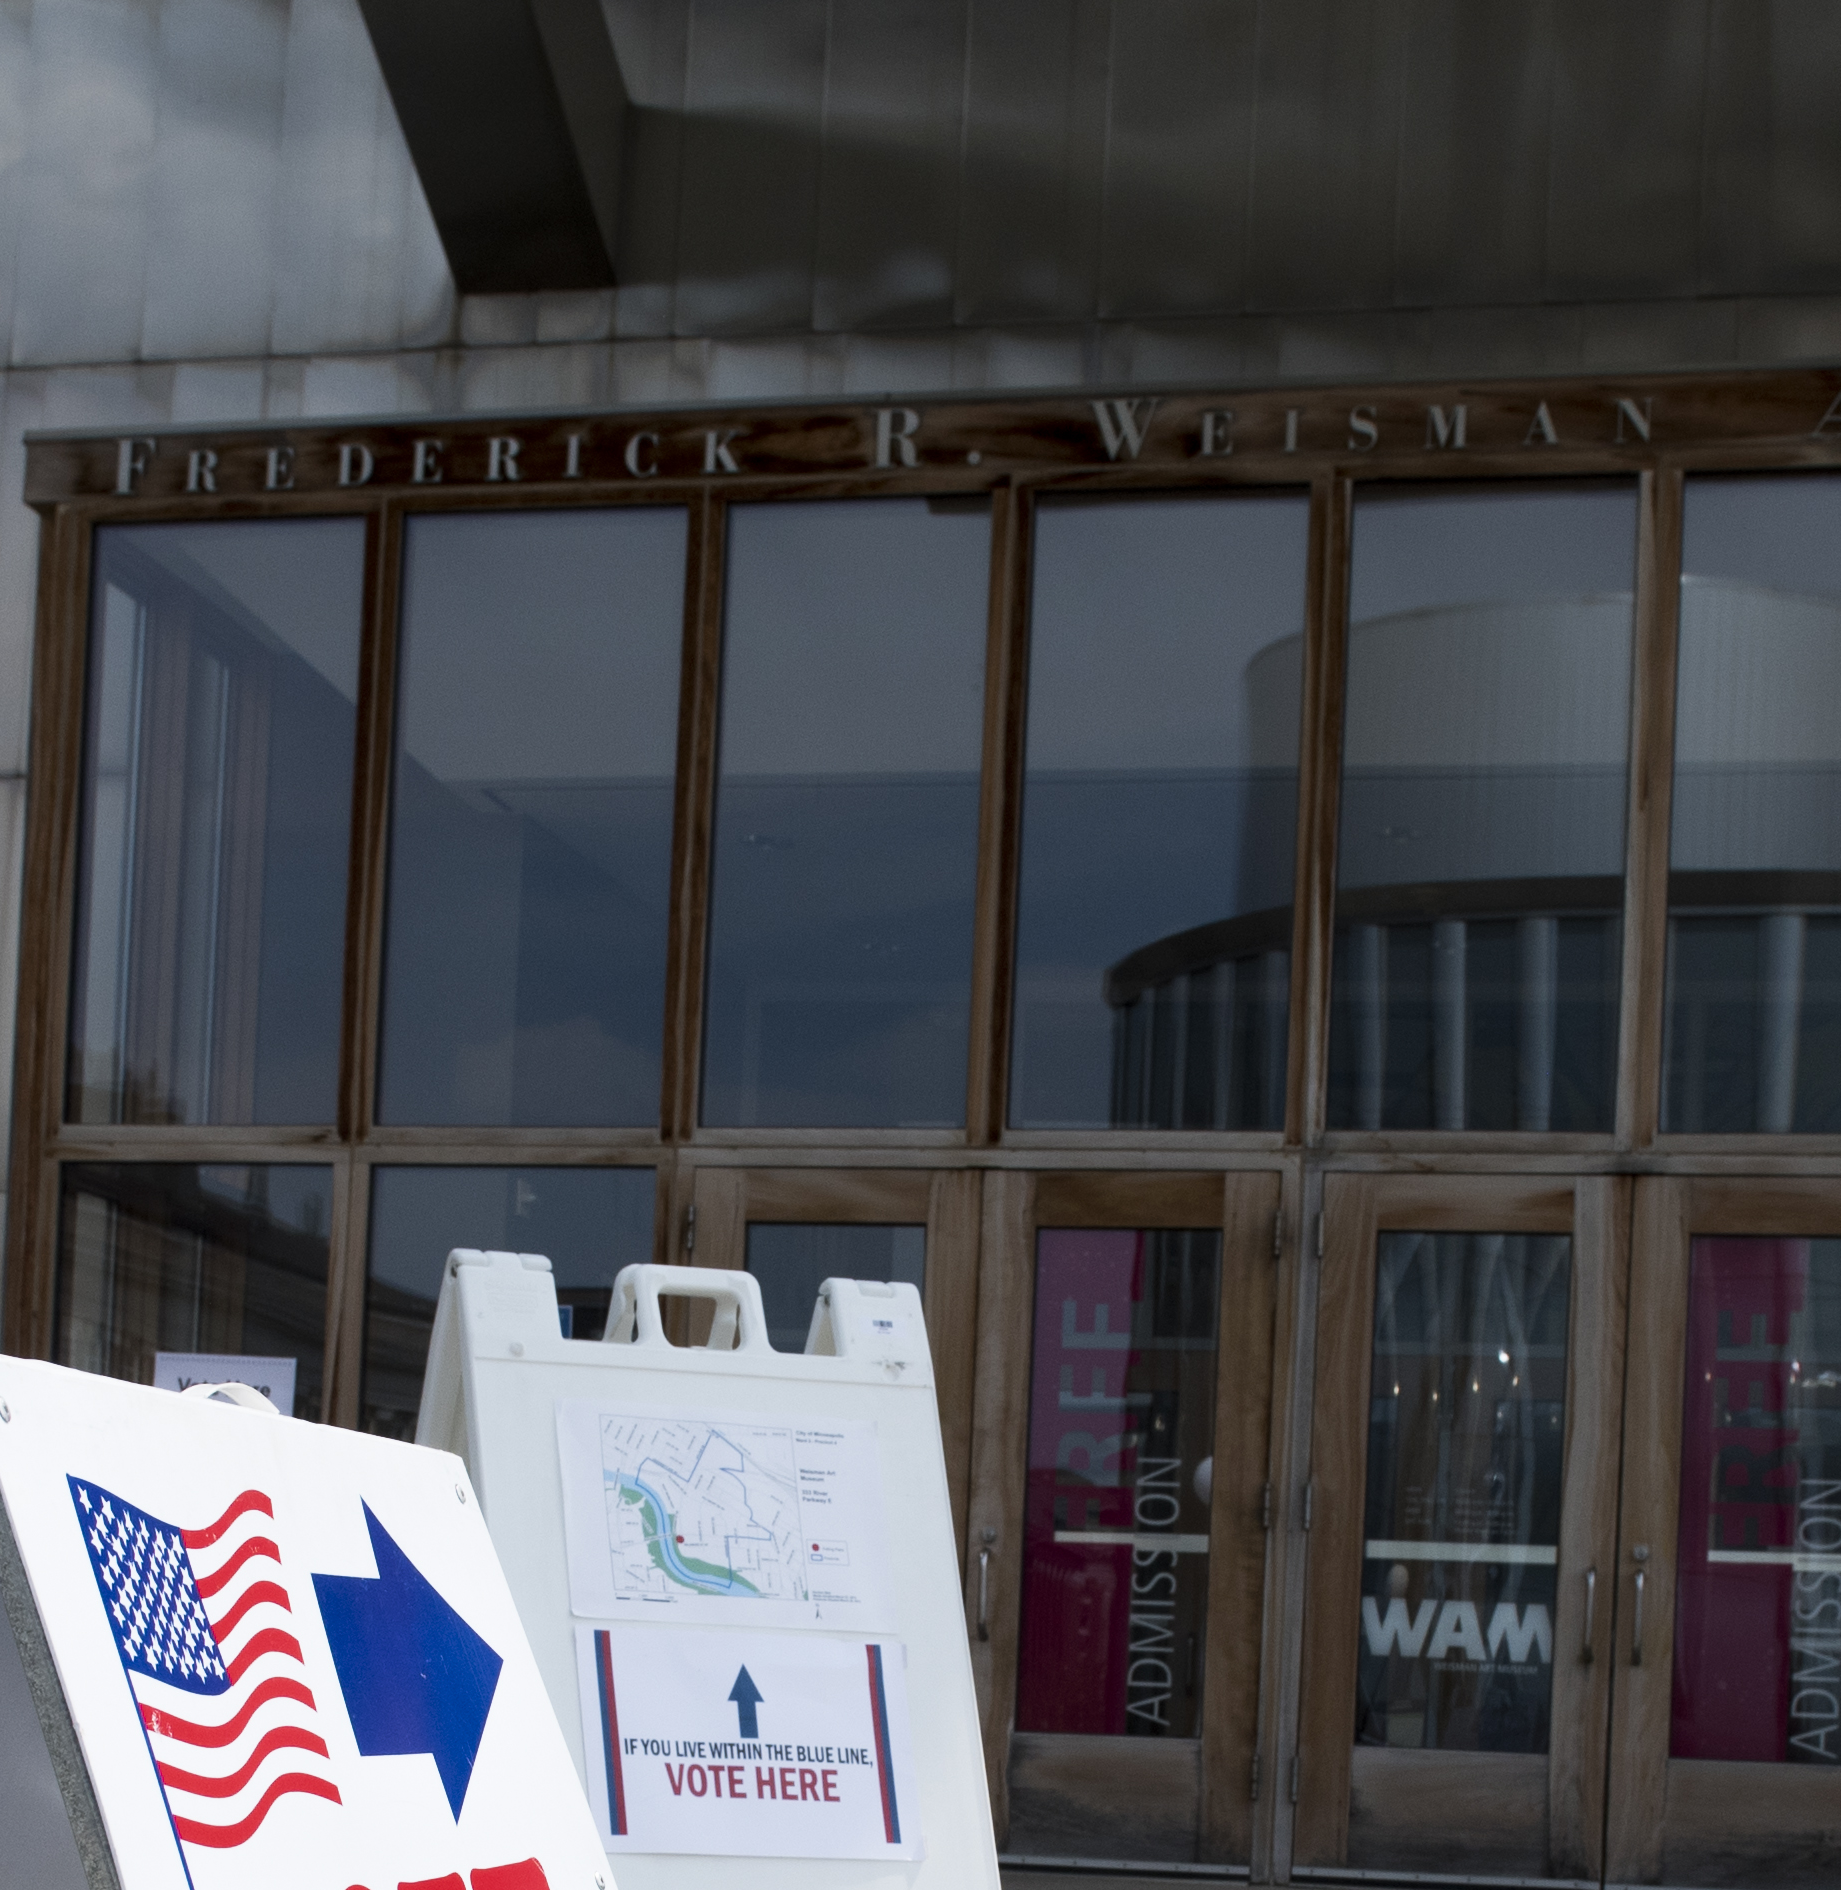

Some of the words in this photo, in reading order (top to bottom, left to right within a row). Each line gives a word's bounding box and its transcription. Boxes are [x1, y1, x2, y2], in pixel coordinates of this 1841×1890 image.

[114, 427, 751, 496] FREDERICK
[869, 405, 982, 468] R.
[1090, 394, 1657, 460] WEISMAN
[1126, 1457, 1181, 1726] ADMISSION
[1361, 1596, 1554, 1664] WAM
[624, 1738, 638, 1755] IF
[640, 1739, 671, 1757] YOU
[676, 1741, 707, 1758] LIVE
[709, 1742, 762, 1760] WITHIN
[765, 1744, 794, 1762] THE
[797, 1745, 833, 1763] BLUE
[837, 1747, 873, 1769] LINE,
[664, 1762, 747, 1798] VOTE
[755, 1766, 841, 1802] HERE
